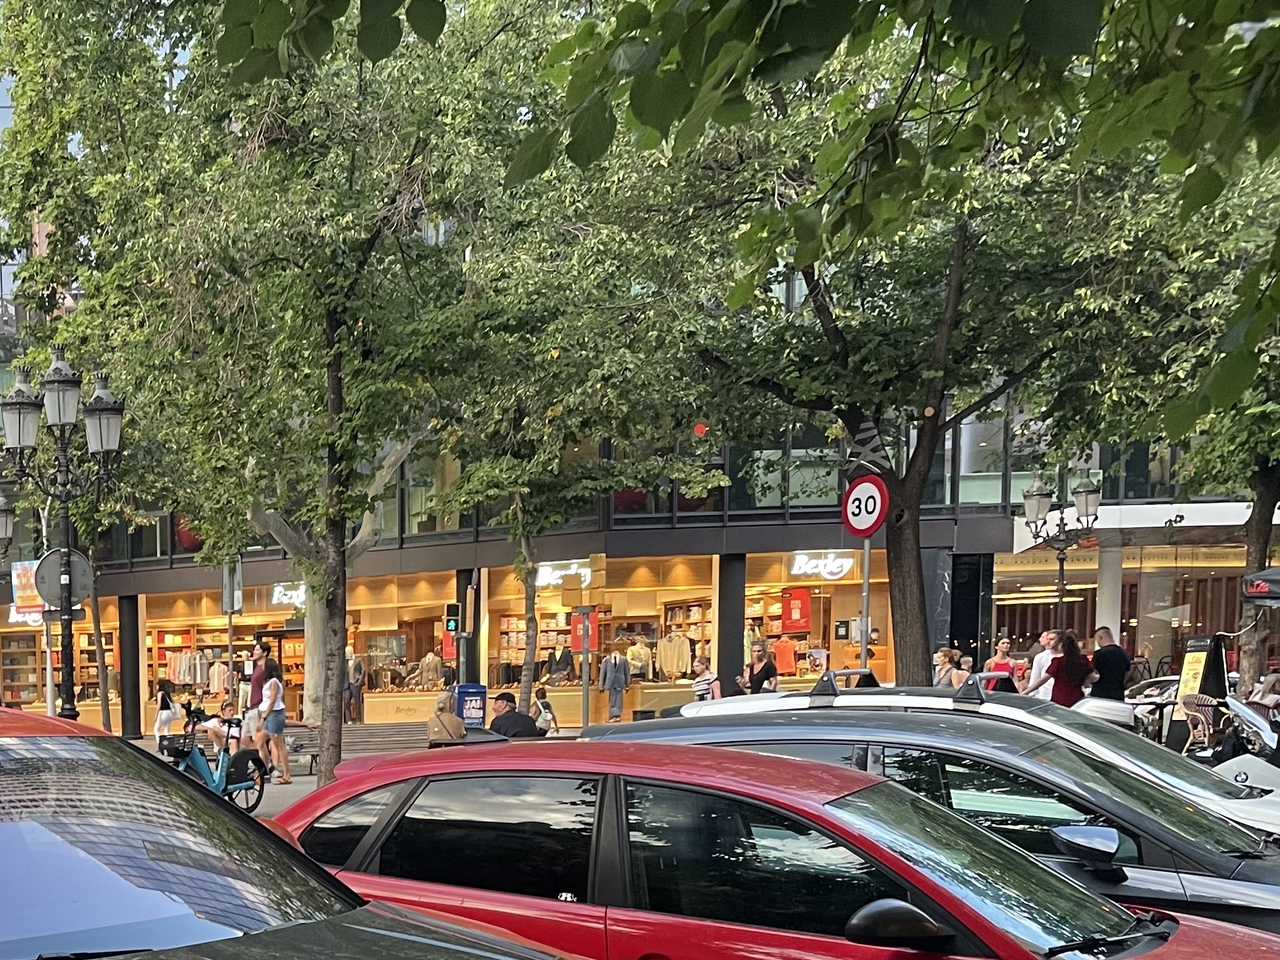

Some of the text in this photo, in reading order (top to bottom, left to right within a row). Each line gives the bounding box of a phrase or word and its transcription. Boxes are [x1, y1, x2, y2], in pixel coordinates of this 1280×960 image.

[851, 495, 877, 517] 30
[791, 553, 854, 579] Bexley
[271, 584, 306, 608] Bexl
